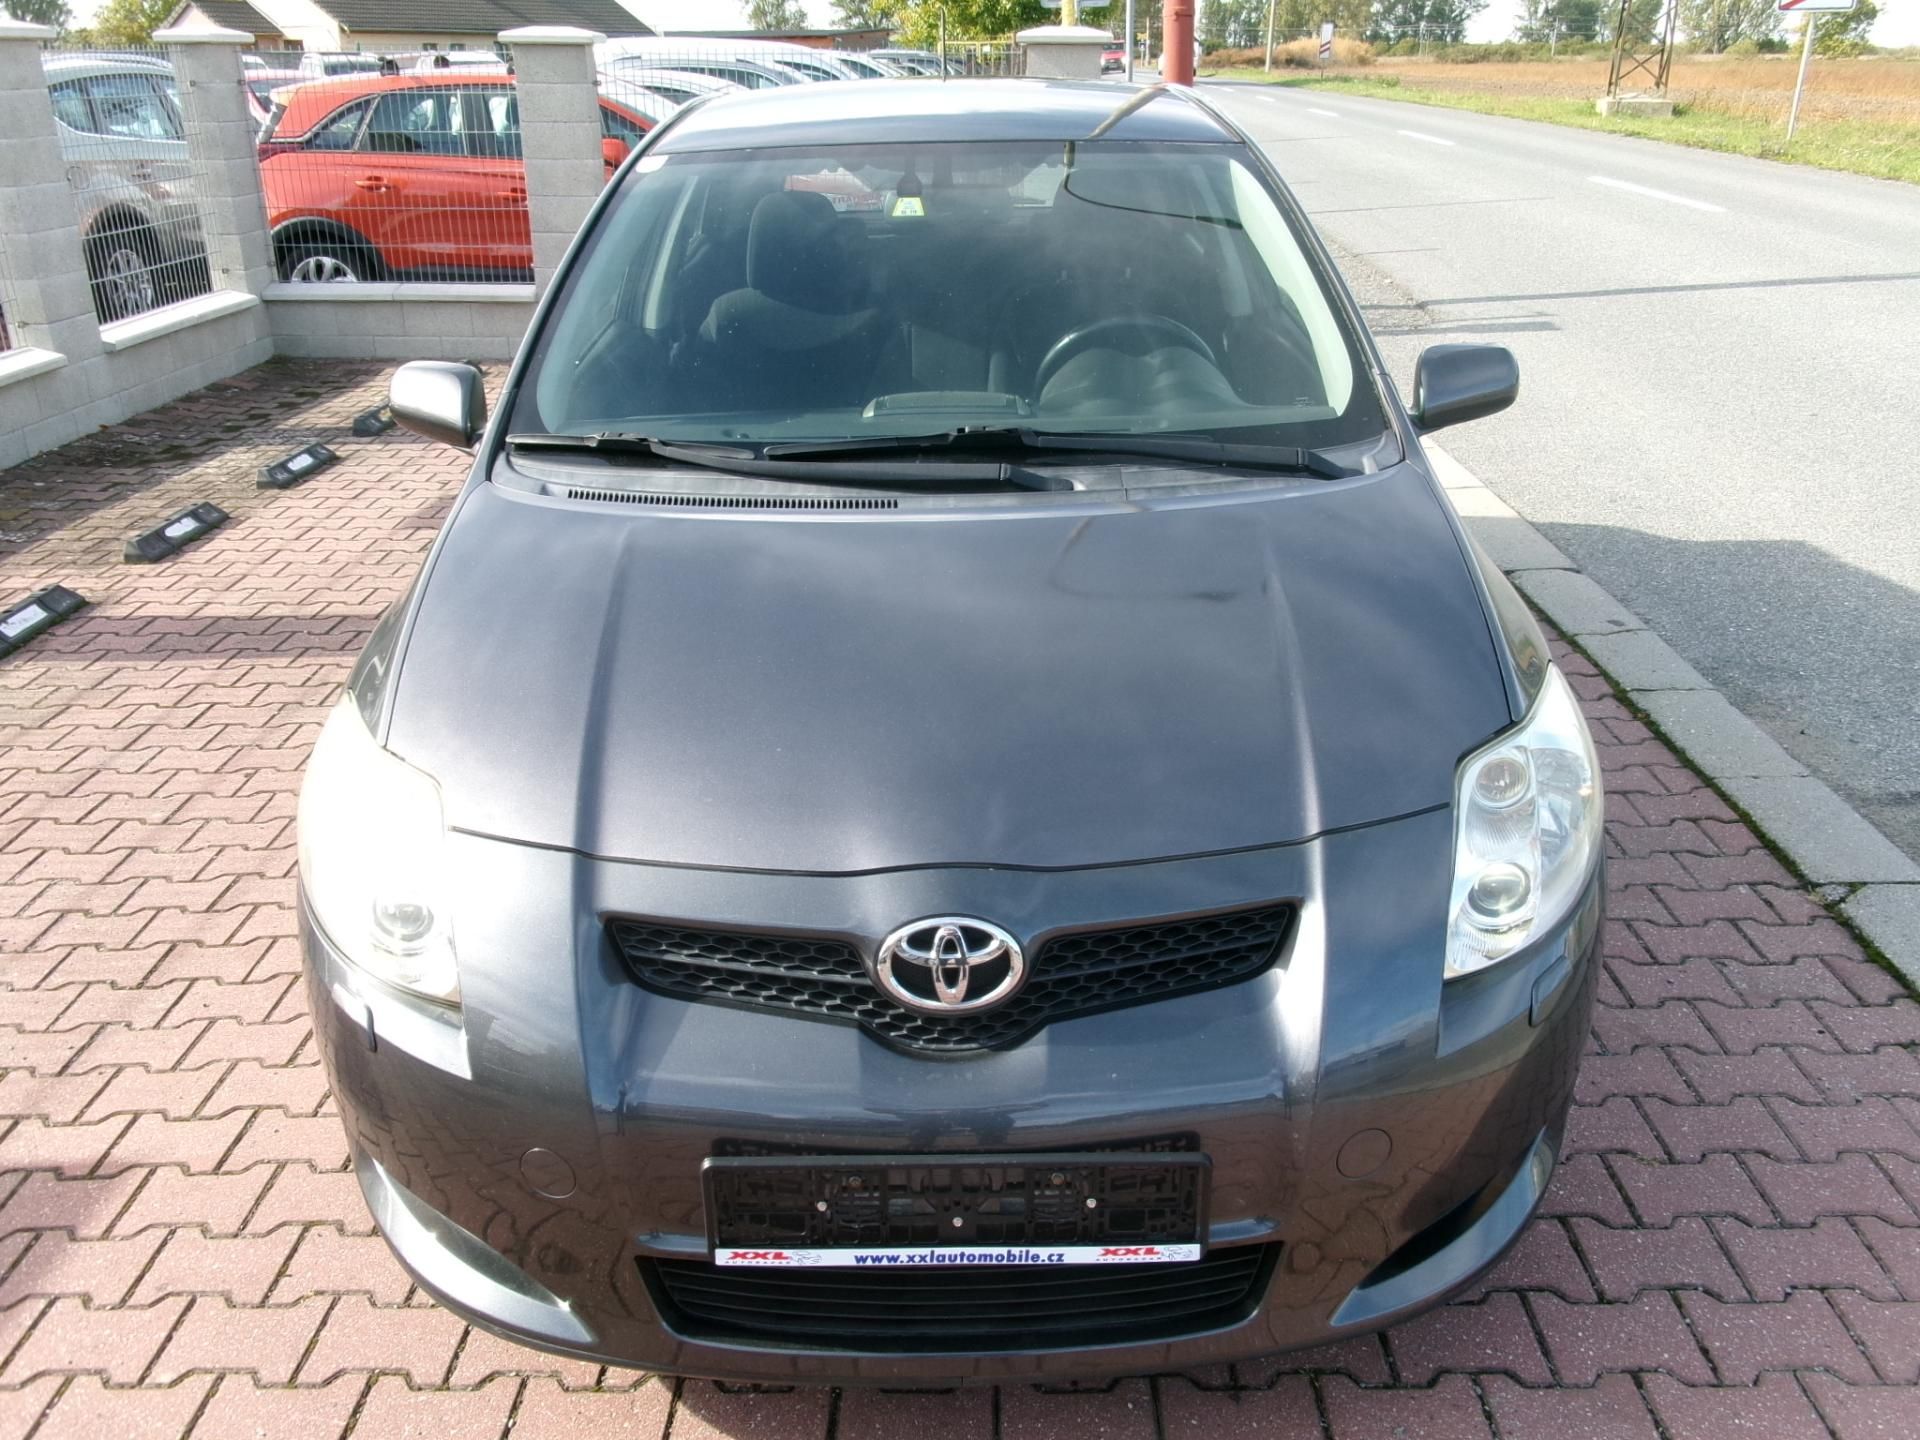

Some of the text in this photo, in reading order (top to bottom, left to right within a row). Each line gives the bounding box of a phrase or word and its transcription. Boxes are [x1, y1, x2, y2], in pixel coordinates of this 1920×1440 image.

[727, 1251, 791, 1260] XXL
[854, 1250, 1065, 1264] www.xxlautomobile.cz
[1098, 1247, 1161, 1257] XXL
